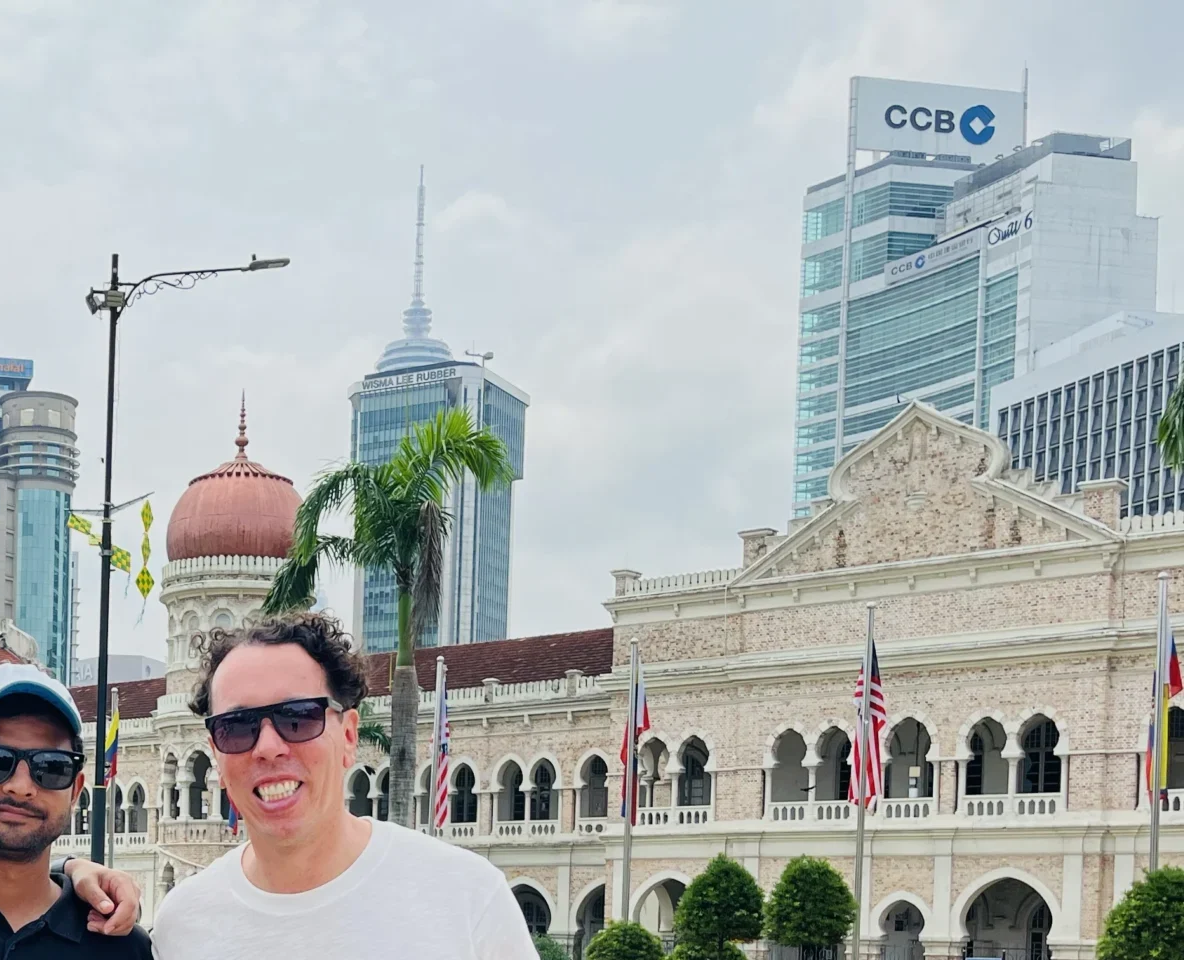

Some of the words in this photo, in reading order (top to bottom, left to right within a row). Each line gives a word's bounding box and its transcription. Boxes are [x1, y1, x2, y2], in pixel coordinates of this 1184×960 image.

[884, 104, 956, 134] CCB
[987, 219, 1022, 246] Quill
[1024, 209, 1033, 230] 6
[891, 260, 913, 276] CCB
[362, 375, 394, 390] WISMA
[396, 373, 414, 386] LEE
[416, 368, 457, 382] RUBBER
